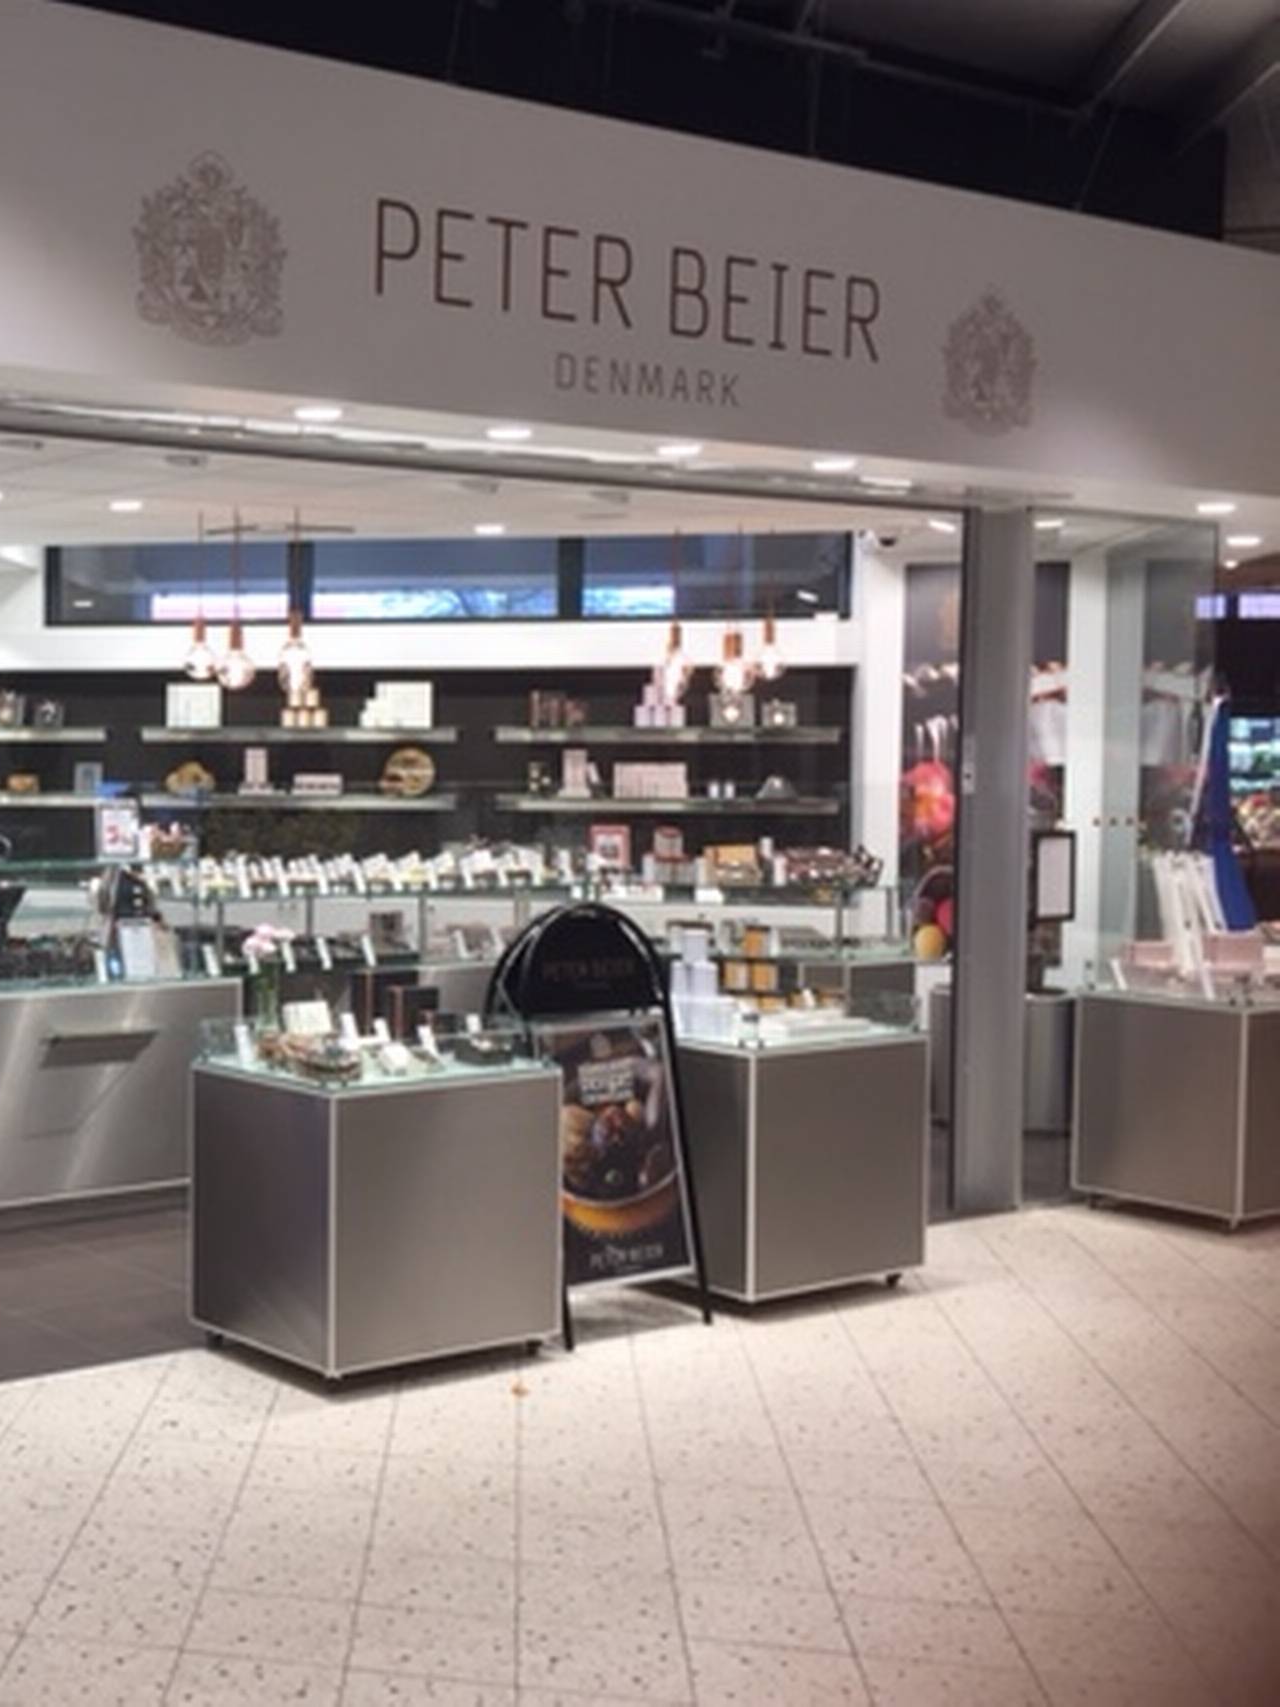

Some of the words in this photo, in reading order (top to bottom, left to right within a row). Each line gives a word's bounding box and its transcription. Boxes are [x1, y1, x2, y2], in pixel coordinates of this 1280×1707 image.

[373, 197, 634, 331] PETER
[668, 246, 882, 363] BEIER
[555, 351, 741, 408] DENMARK
